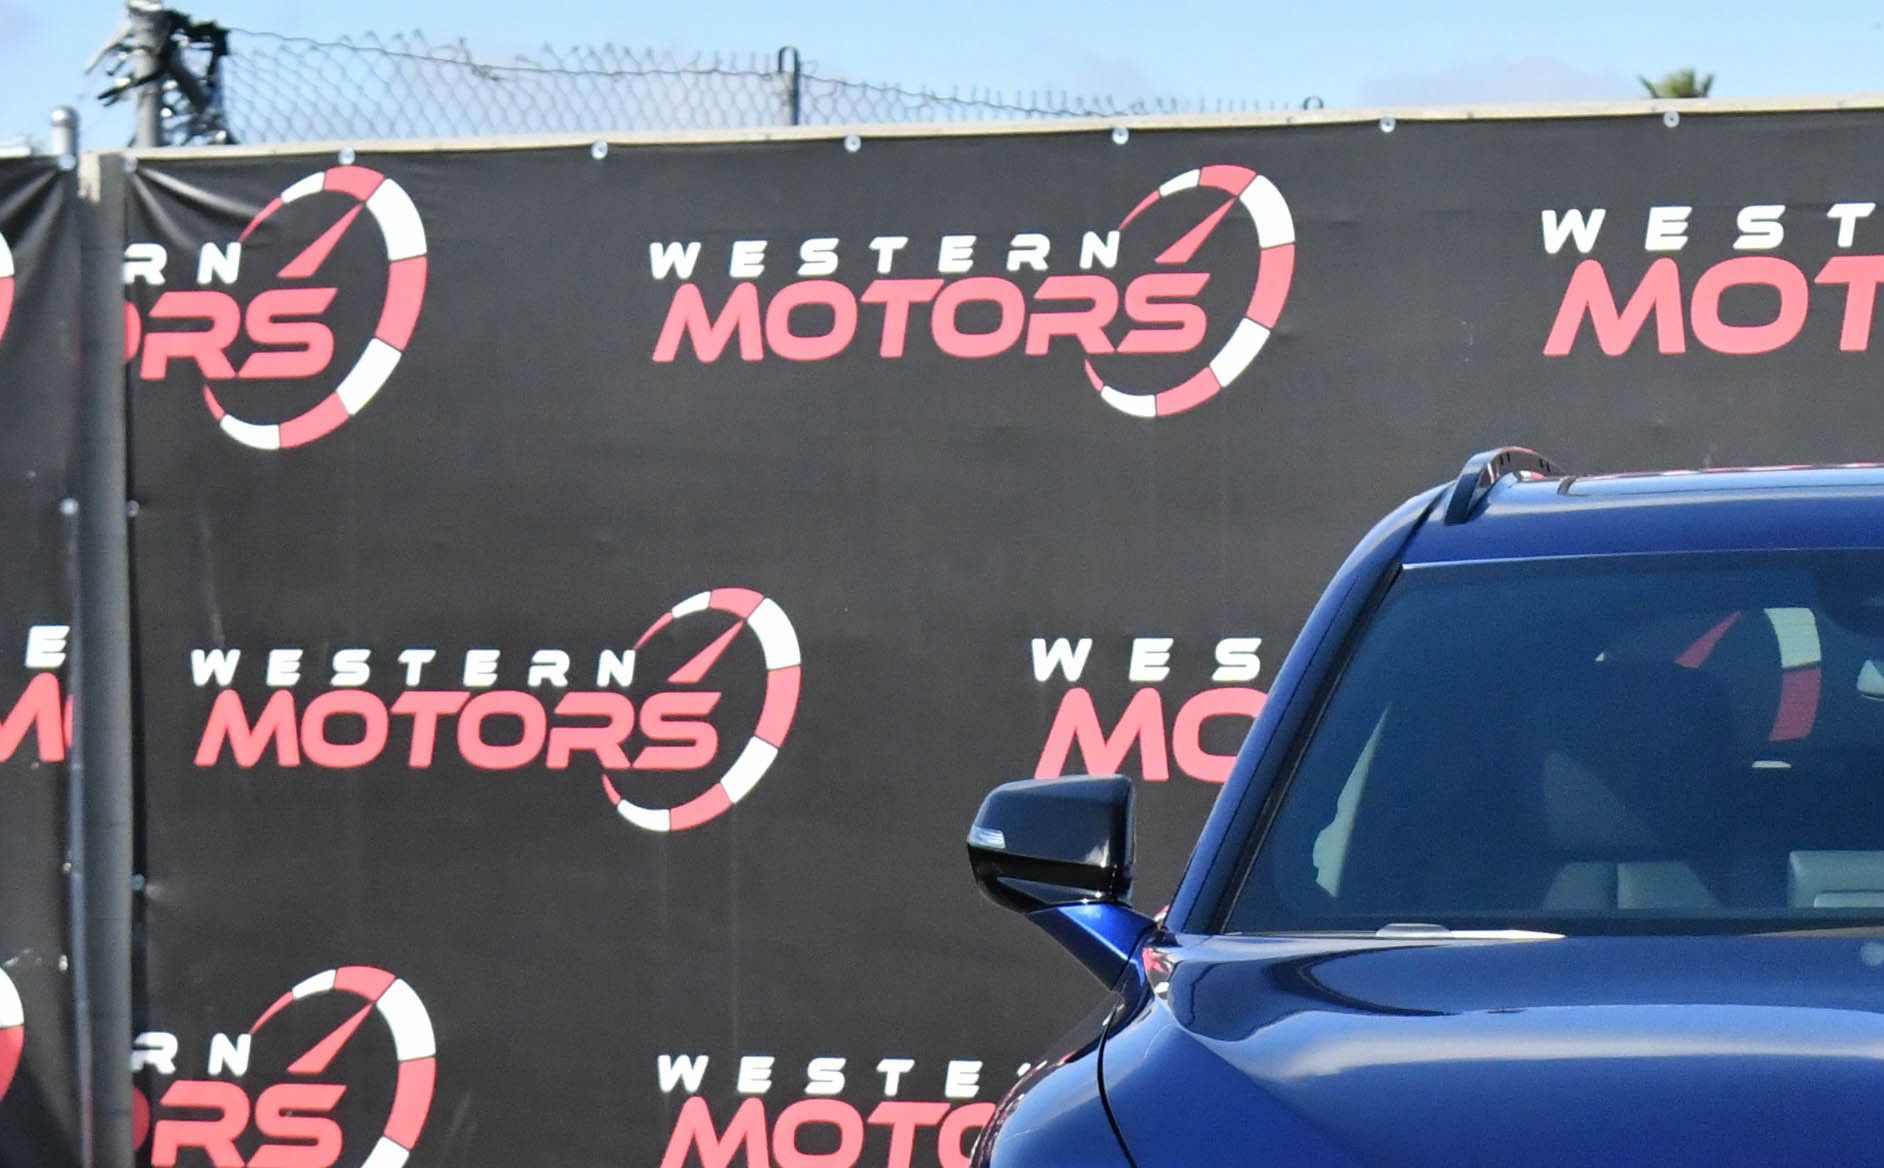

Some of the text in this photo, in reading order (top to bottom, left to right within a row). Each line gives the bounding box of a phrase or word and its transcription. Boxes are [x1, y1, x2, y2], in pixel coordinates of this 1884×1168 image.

[649, 230, 1121, 280] WESTERN
[653, 271, 1211, 364] MOTORS
[191, 648, 636, 687] WESTERN
[194, 688, 721, 771] MOTORS
